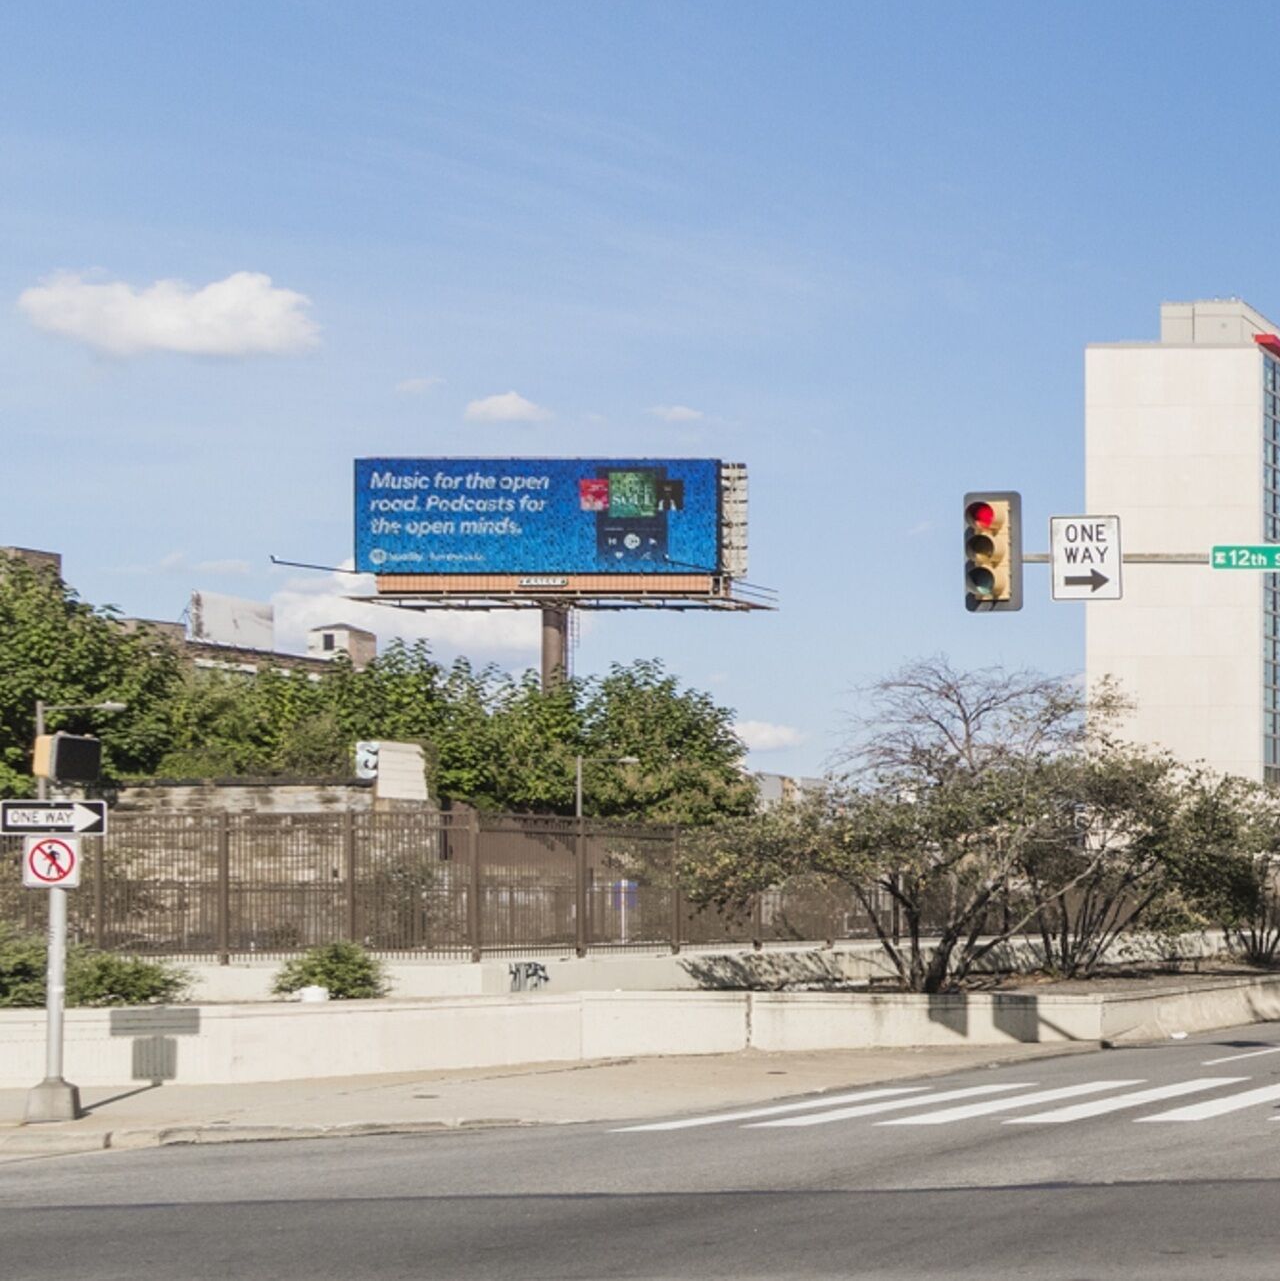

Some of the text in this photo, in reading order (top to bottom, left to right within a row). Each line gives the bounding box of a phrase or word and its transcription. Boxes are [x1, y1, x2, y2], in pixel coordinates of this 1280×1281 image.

[370, 471, 550, 493] Music for the open
[370, 494, 547, 512] road. Podcasts for
[371, 517, 523, 537] the open minds.
[1065, 523, 1107, 543] ONE
[1064, 546, 1109, 564] WAY
[1228, 549, 1268, 566] 12th
[10, 811, 74, 824] ONE WAY
